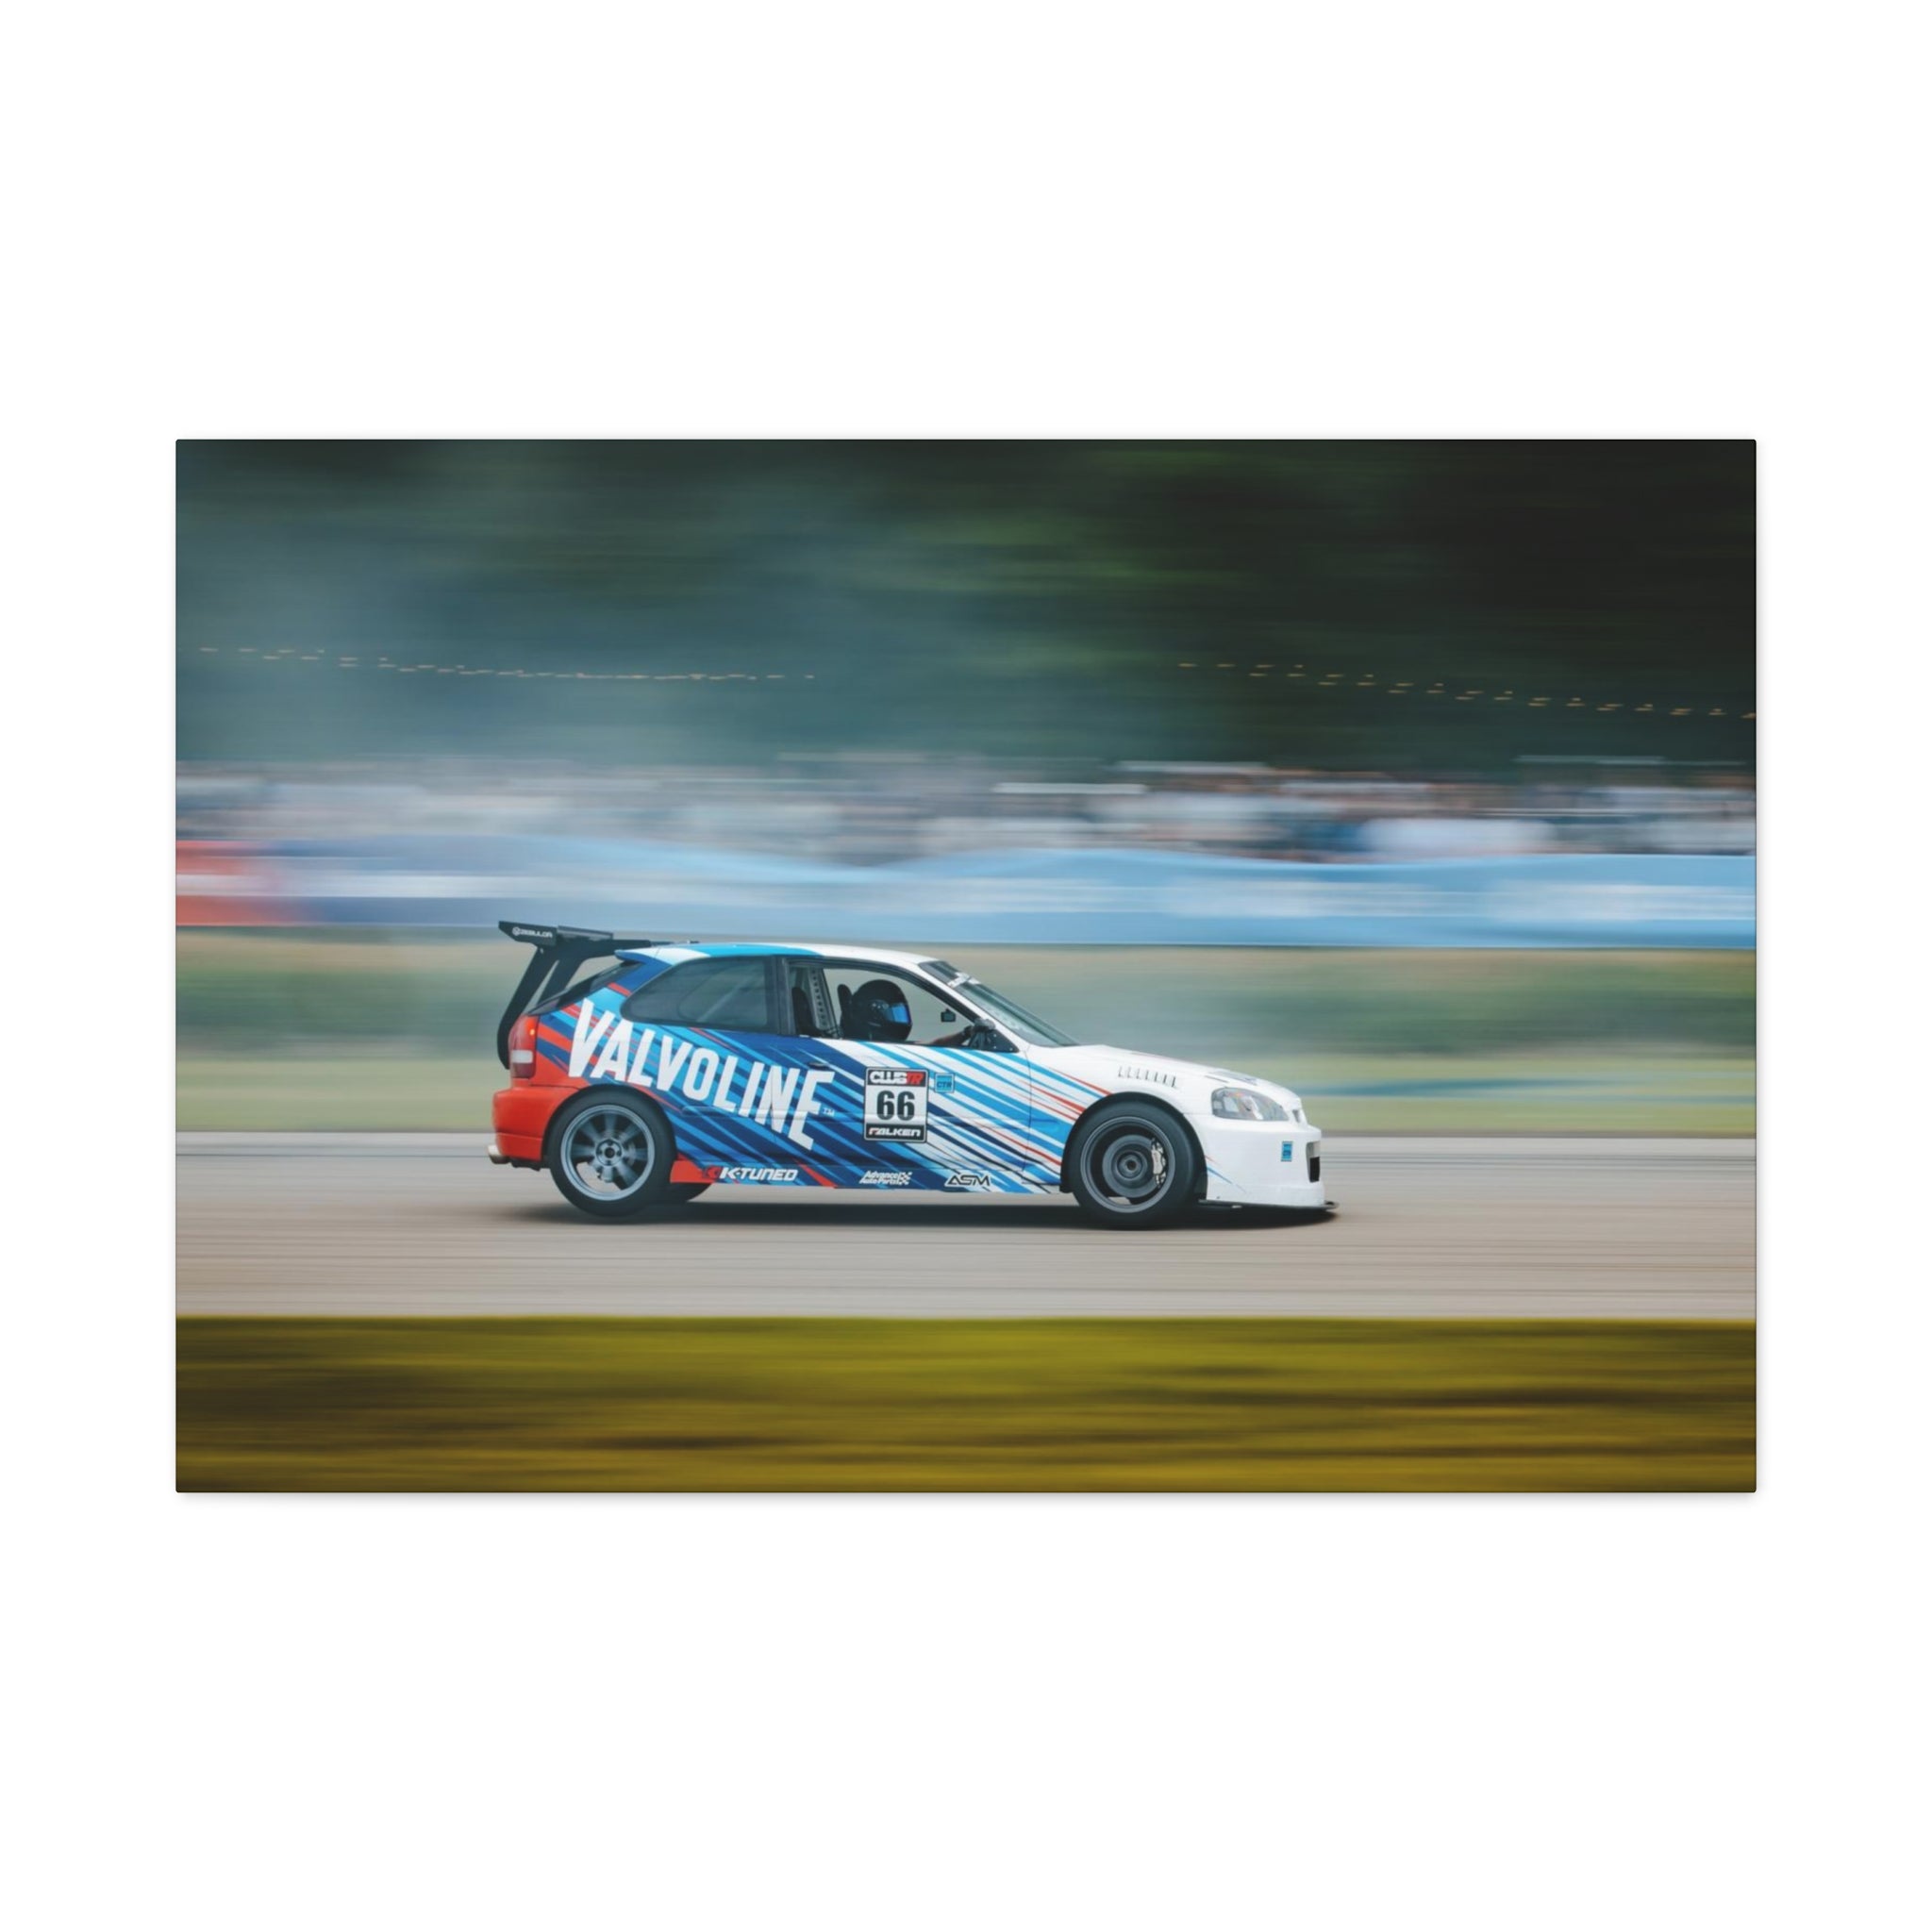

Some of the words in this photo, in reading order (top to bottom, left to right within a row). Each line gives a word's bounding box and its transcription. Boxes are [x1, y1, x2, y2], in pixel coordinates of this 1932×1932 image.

[568, 997, 835, 1151] VALVOLINE
[876, 1090, 915, 1121] 66
[868, 1127, 921, 1137] FALKEN
[719, 1167, 798, 1181] K-TUNED
[946, 1174, 991, 1186] ASM
